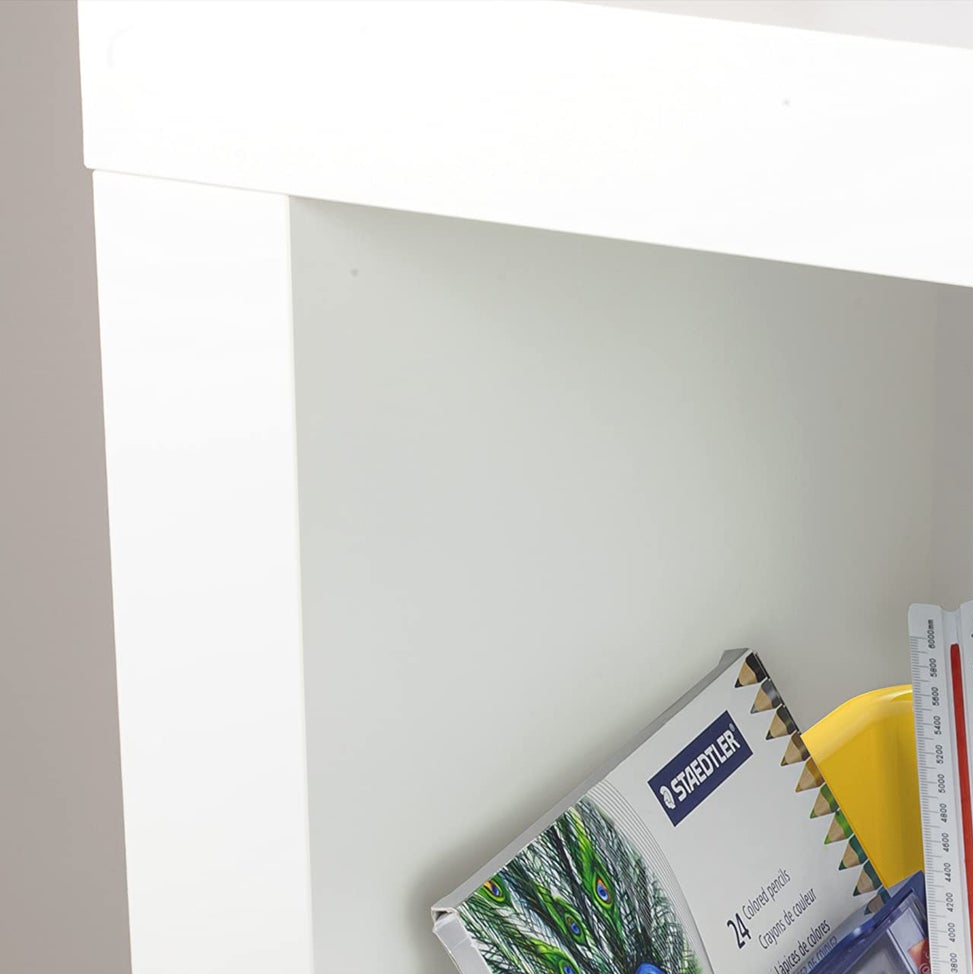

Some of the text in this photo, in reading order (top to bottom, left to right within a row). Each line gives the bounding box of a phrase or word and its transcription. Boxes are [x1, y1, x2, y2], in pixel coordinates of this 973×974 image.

[929, 658, 938, 678] 5800
[931, 686, 940, 706] 5600
[934, 716, 942, 734] 5400
[936, 744, 944, 764] 5200
[670, 730, 740, 802] STAEDTLER
[938, 774, 946, 794] 5000
[940, 803, 948, 823] 4800
[942, 832, 950, 852] 4600
[944, 862, 952, 882] 4400
[726, 868, 791, 949] 24 Colored pencils
[946, 892, 954, 912] 4200
[758, 888, 817, 950] Crayons de couleur
[798, 940, 810, 956] de
[808, 920, 831, 948] colores
[947, 922, 956, 942] 4000
[950, 952, 958, 974] 3800
